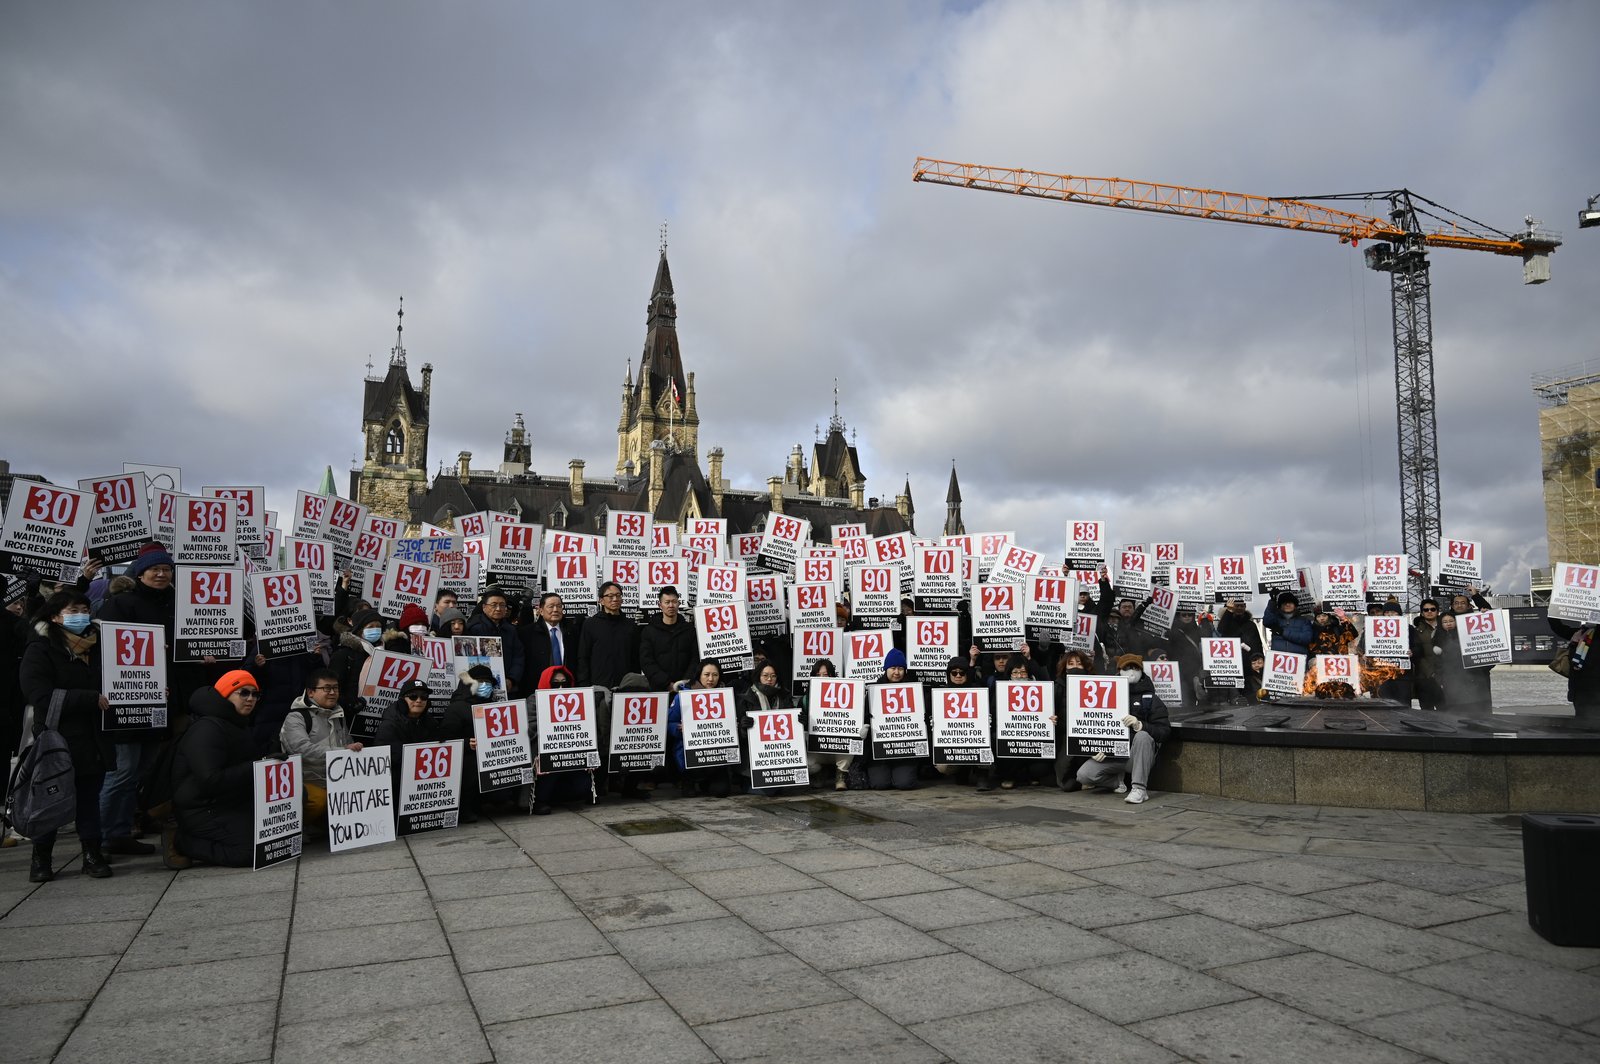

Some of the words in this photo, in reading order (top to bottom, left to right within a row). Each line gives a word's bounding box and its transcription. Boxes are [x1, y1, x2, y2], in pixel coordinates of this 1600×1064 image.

[100, 479, 131, 511] 30
[30, 489, 73, 523] 30
[306, 496, 324, 520] 39
[192, 501, 222, 531] 36
[334, 504, 356, 529] 42
[464, 516, 484, 535] 25
[620, 515, 642, 535] 53
[25, 523, 67, 537] MONTHS
[504, 527, 527, 549] 11
[775, 519, 798, 539] 33
[1076, 524, 1096, 540] 38
[4, 540, 27, 550] IRCC
[26, 543, 78, 558] RESPONSE
[13, 531, 52, 544] WAITING
[54, 538, 76, 548] FOR
[358, 535, 379, 558] 32
[397, 539, 423, 552] STOP
[429, 538, 452, 550] THE
[558, 535, 578, 552] 15
[743, 537, 761, 554] 33
[845, 539, 864, 558] 46
[985, 535, 1004, 554] 37
[299, 543, 321, 569] 40
[879, 538, 903, 561] 33
[1159, 545, 1176, 559] 28
[1265, 547, 1284, 564] 31
[1451, 542, 1472, 559] 37
[560, 557, 583, 578] 71
[685, 550, 702, 570] 34
[928, 551, 950, 572] 70
[1007, 548, 1033, 571] 35
[1125, 554, 1143, 571] 32
[1223, 559, 1242, 574] 37
[1377, 558, 1397, 574] 33
[616, 561, 638, 583] 53
[652, 563, 675, 583] 63
[808, 560, 829, 580] 55
[1180, 569, 1196, 584] 37
[1330, 566, 1352, 583] 34
[1571, 569, 1592, 588] 14
[195, 574, 227, 604] 34
[399, 565, 426, 595] 54
[711, 569, 734, 591] 68
[864, 569, 887, 591] 90
[267, 576, 298, 606] 38
[751, 579, 773, 601] 55
[801, 588, 823, 608] 34
[985, 587, 1011, 611] 22
[1039, 580, 1060, 602] 11
[1154, 589, 1170, 608] 30
[194, 607, 227, 616] MONTHS
[265, 615, 291, 627] WAITING
[293, 614, 307, 623] FOR
[270, 605, 299, 617] MONTHS
[709, 607, 735, 632] 39
[985, 612, 1010, 620] MONTHS
[181, 627, 198, 635] IRCC
[199, 626, 238, 636] RESPONSE
[186, 617, 216, 626] WAITING
[219, 618, 235, 626] FOR
[261, 627, 277, 636] IRCC
[277, 621, 312, 635] RESPONSE
[990, 626, 1020, 634] RESPONSE
[1376, 620, 1397, 637] 39
[1468, 615, 1495, 633] 25
[920, 622, 945, 645] 65
[120, 630, 149, 664] 37
[198, 640, 230, 649] TIMELINES
[201, 647, 228, 656] RESULTS
[807, 632, 830, 655] 40
[855, 635, 880, 658] 72
[1212, 641, 1233, 658] 23
[1153, 665, 1171, 681] 22
[1275, 655, 1296, 673] 20
[1327, 658, 1348, 675] 39
[120, 669, 150, 679] MONTHS
[384, 659, 415, 689] 42
[113, 680, 141, 690] WAITING
[144, 681, 158, 690] FOR
[108, 692, 125, 701] IRCC
[125, 690, 162, 701] RESPONSE
[824, 683, 851, 708] 40
[885, 688, 911, 713] 51
[1011, 686, 1040, 712] 36
[1083, 682, 1112, 708] 37
[554, 694, 581, 721] 62
[628, 698, 652, 724] 81
[695, 693, 722, 719] 35
[947, 693, 974, 718] 34
[490, 707, 516, 736] 31
[553, 723, 581, 733] MONTHS
[763, 714, 789, 740] 43
[879, 723, 904, 731] WAITING
[885, 715, 911, 723] MONTHS
[947, 721, 974, 729] MONTHS
[547, 732, 573, 742] WAITING
[576, 731, 589, 739] FOR
[890, 729, 923, 739] RESPONSE
[952, 736, 985, 744] RESPONSE
[543, 742, 558, 750] IRCC
[559, 738, 592, 749] RESPONSE
[328, 756, 391, 782] CANADA
[418, 748, 448, 779] 36
[269, 763, 291, 801] 18
[416, 779, 446, 792] MONTHS
[328, 791, 365, 815] WHAT
[366, 789, 389, 810] ARE
[404, 802, 419, 812] IRCC
[420, 796, 455, 810] RESPONSE
[409, 790, 436, 802] WAITING
[438, 788, 453, 798] FOR
[330, 823, 352, 845] YOU
